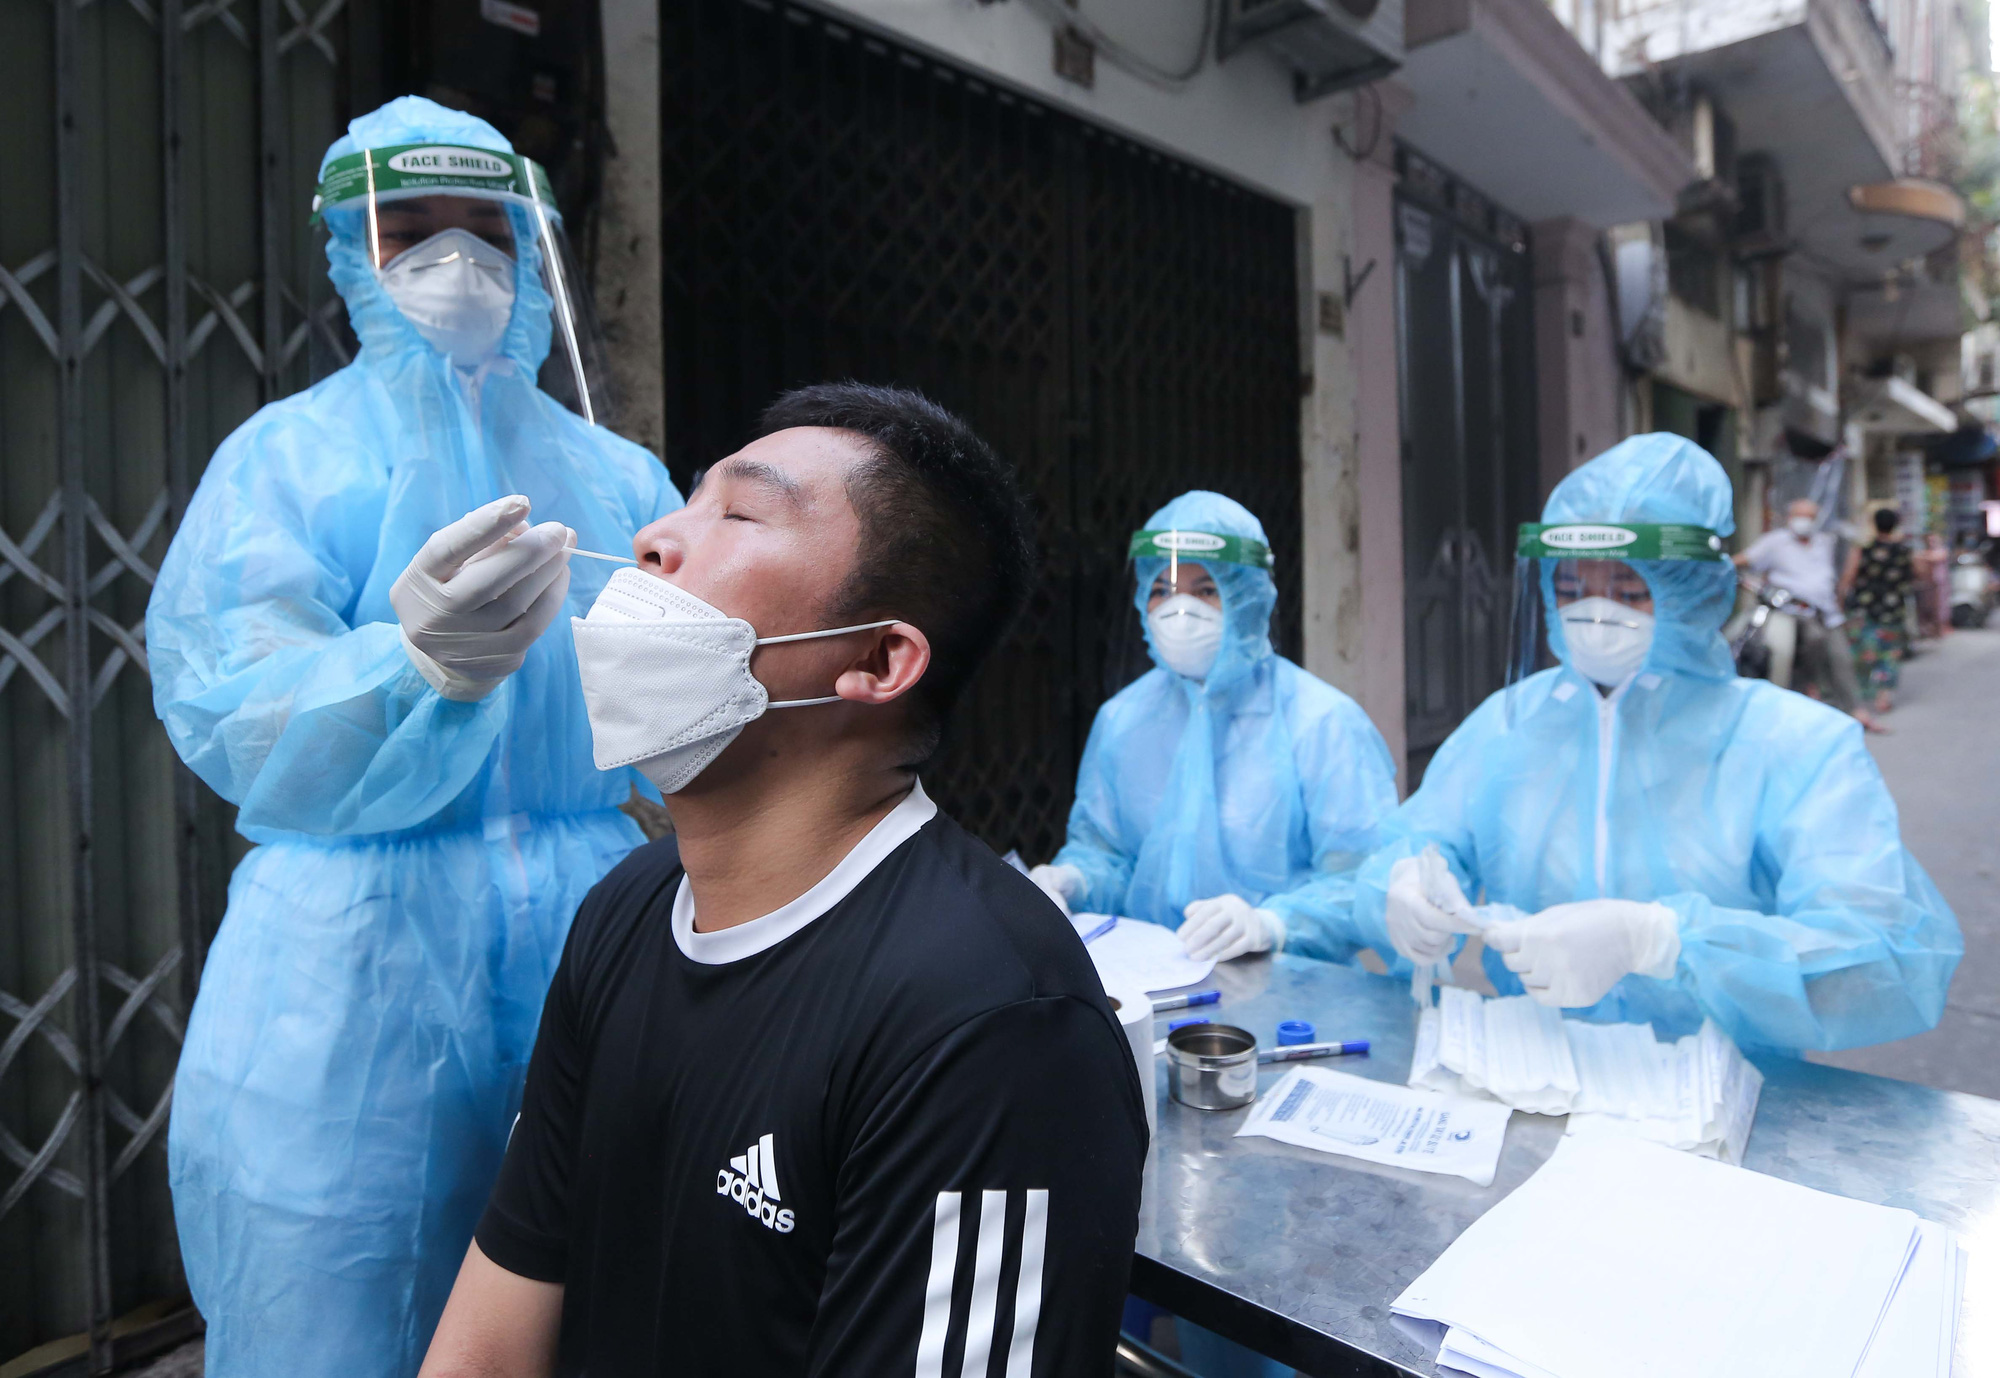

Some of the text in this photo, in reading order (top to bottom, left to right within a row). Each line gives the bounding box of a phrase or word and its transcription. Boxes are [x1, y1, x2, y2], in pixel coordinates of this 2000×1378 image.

[402, 155, 502, 173] FACE SHIELD
[1580, 533, 1625, 542] SHIELD
[717, 1169, 795, 1233] adidas
